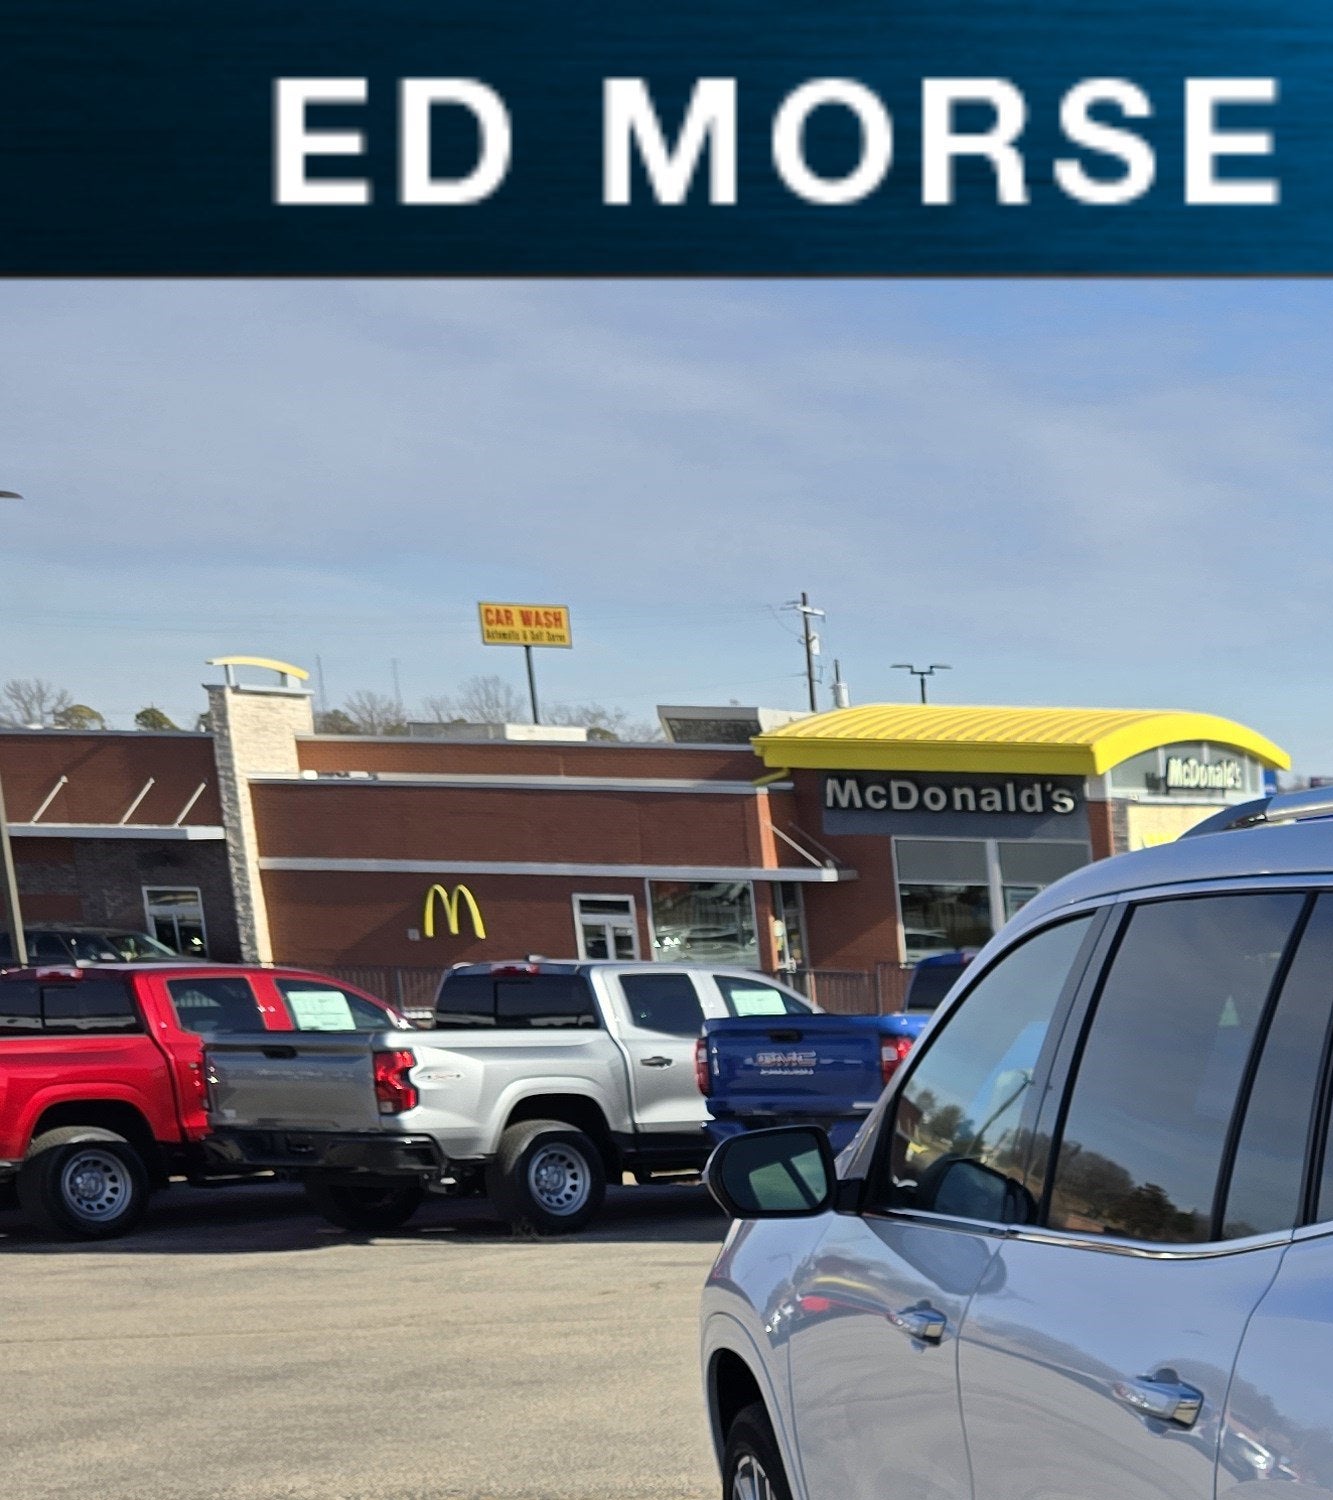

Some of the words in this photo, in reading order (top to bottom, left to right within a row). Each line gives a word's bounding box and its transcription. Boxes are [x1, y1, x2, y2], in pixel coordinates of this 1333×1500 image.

[485, 608, 514, 626] CAR
[520, 610, 563, 628] WASH
[1167, 757, 1241, 789] McDonald's
[825, 778, 1076, 814] McDonald's
[756, 1051, 817, 1067] GMC
